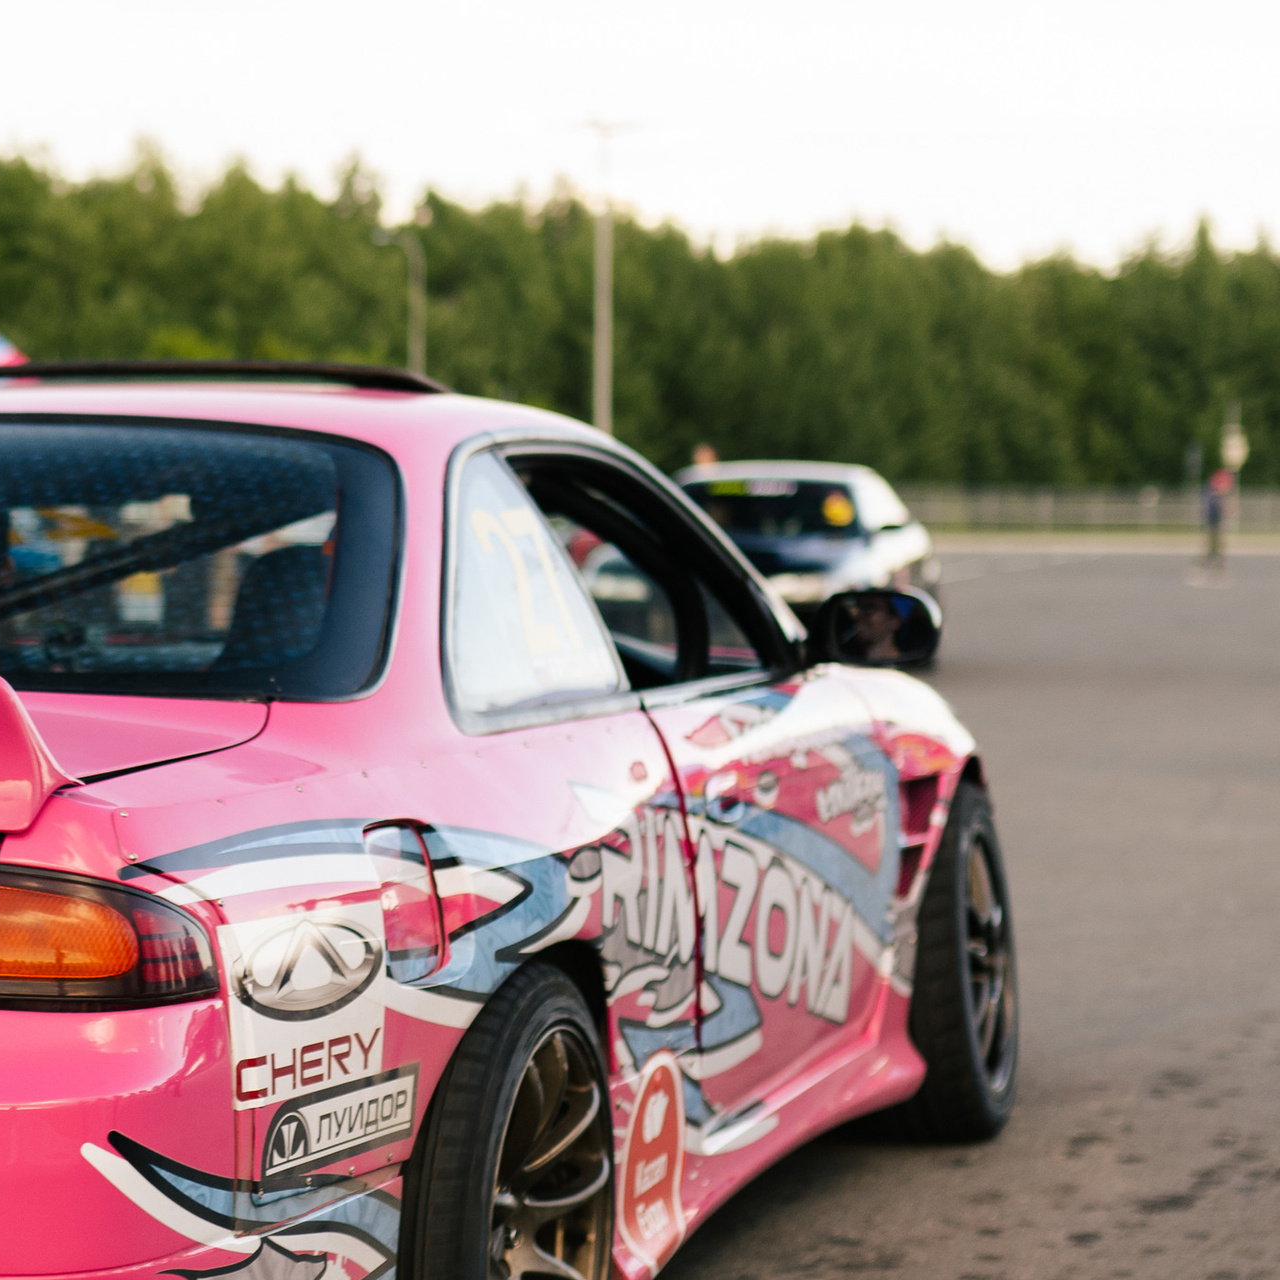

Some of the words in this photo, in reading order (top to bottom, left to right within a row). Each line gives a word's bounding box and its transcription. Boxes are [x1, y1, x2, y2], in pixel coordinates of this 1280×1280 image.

[600, 806, 855, 1025] RIMZONA
[236, 1027, 382, 1102] CHERY
[316, 1088, 408, 1145] ЛУИДОР
